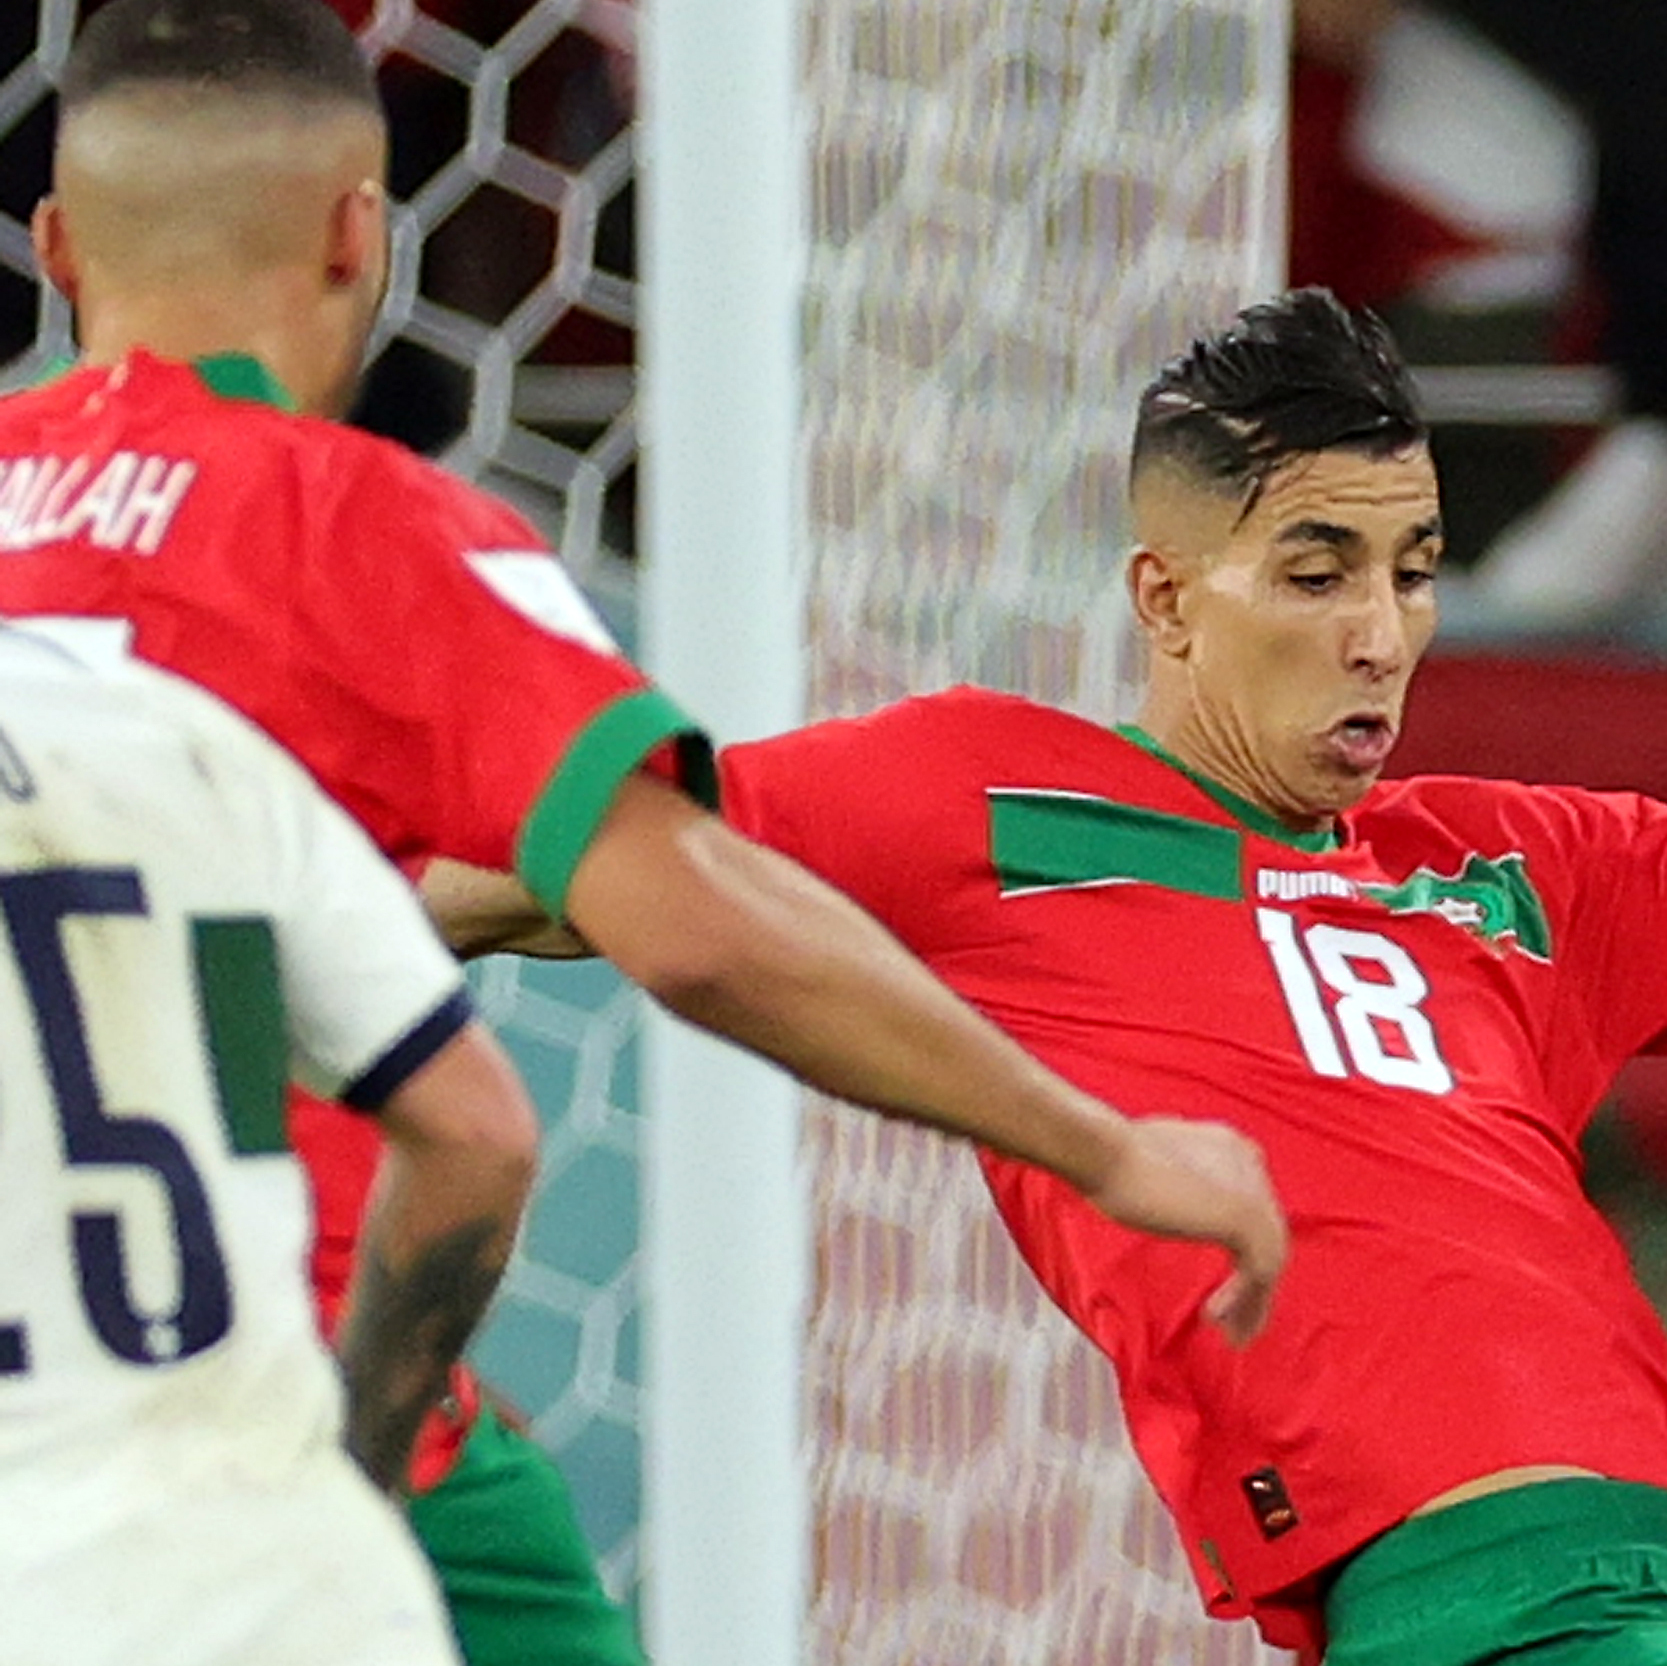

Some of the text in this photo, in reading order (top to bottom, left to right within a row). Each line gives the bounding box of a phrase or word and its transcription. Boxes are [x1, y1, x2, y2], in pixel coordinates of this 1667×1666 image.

[1256, 868, 1358, 902] PUMA
[1255, 906, 1456, 1096] 18
[0, 865, 234, 1370] 5
